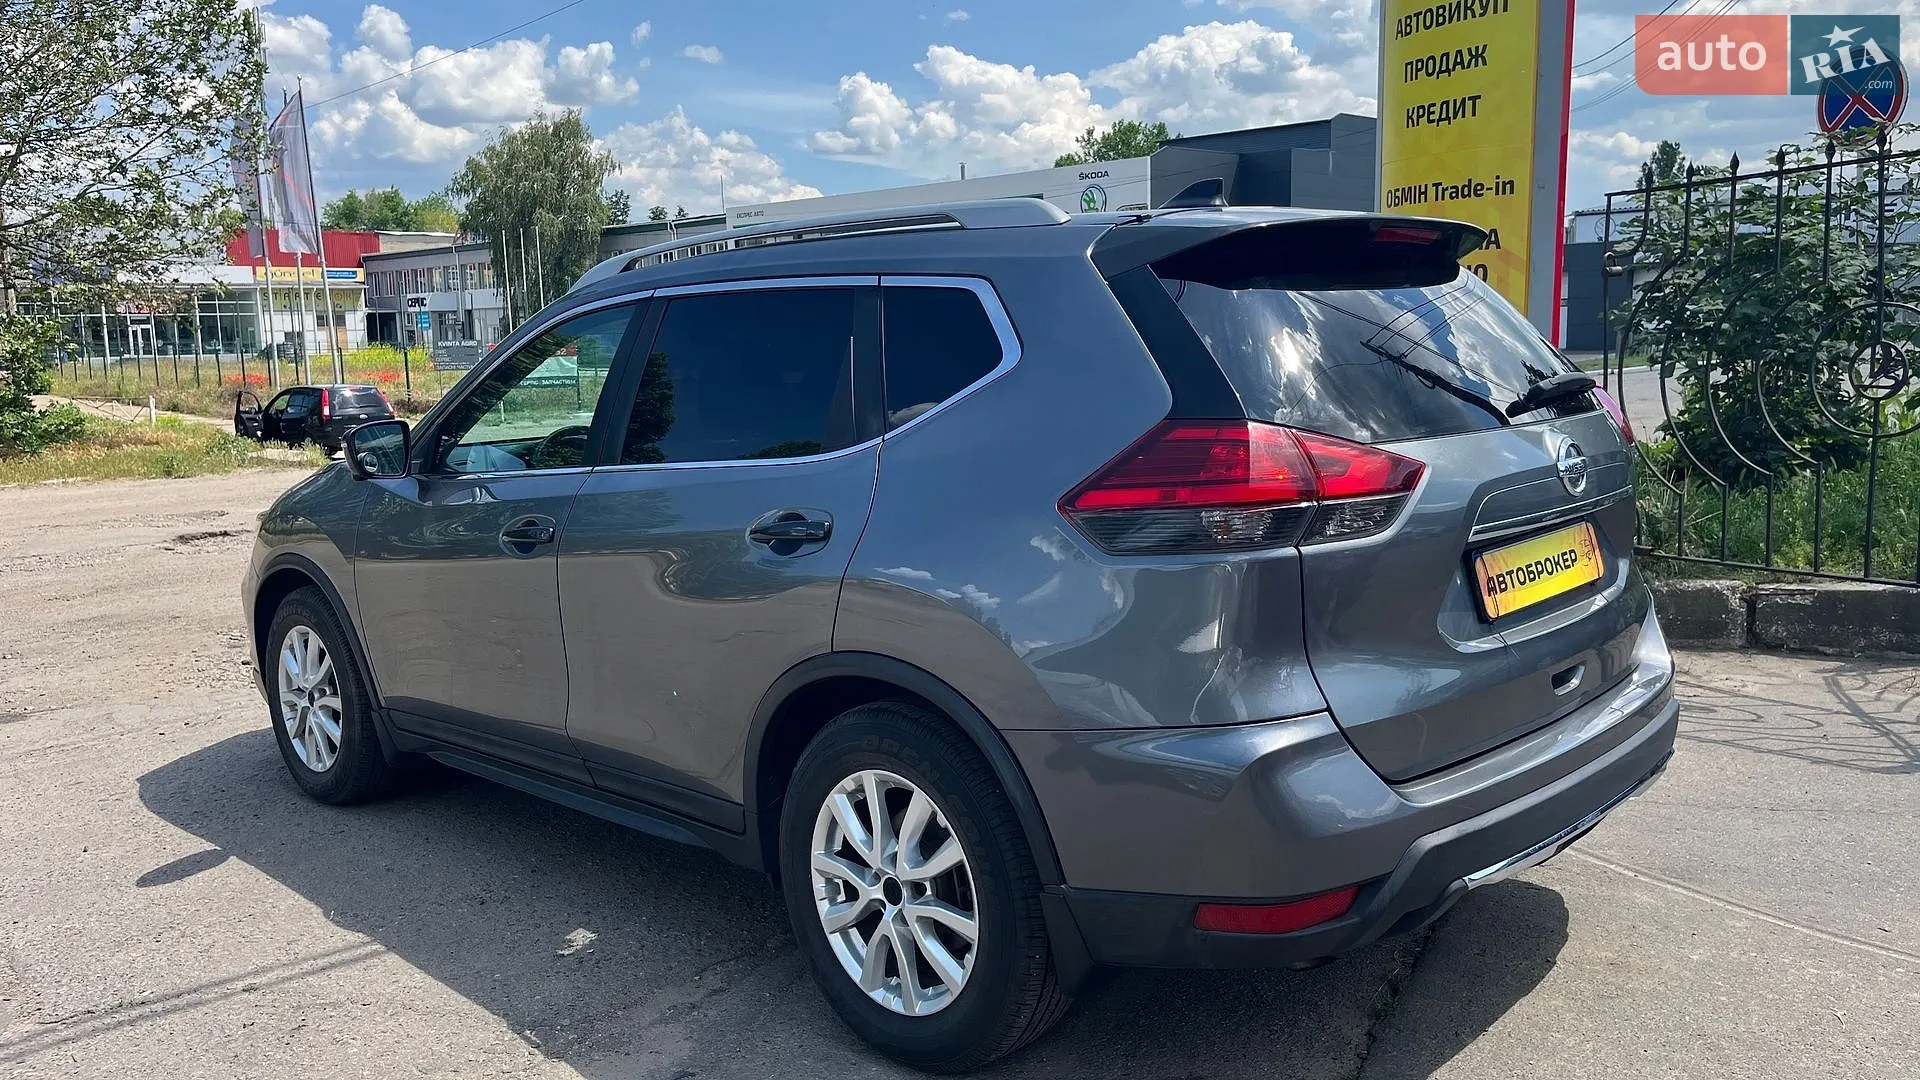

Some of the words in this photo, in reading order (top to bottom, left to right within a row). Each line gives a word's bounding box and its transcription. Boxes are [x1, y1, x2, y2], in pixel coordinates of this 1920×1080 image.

[1395, 0, 1509, 40] АВТОВИКУП
[1404, 44, 1488, 83] ПРОДАЖ
[1406, 95, 1481, 128] КРЕДИТ
[1078, 170, 1109, 180] ŠKODA
[1386, 183, 1429, 209] ОБМІН
[1431, 175, 1515, 202] Trade-in
[1486, 548, 1578, 598] АВТОБРОКЕР
